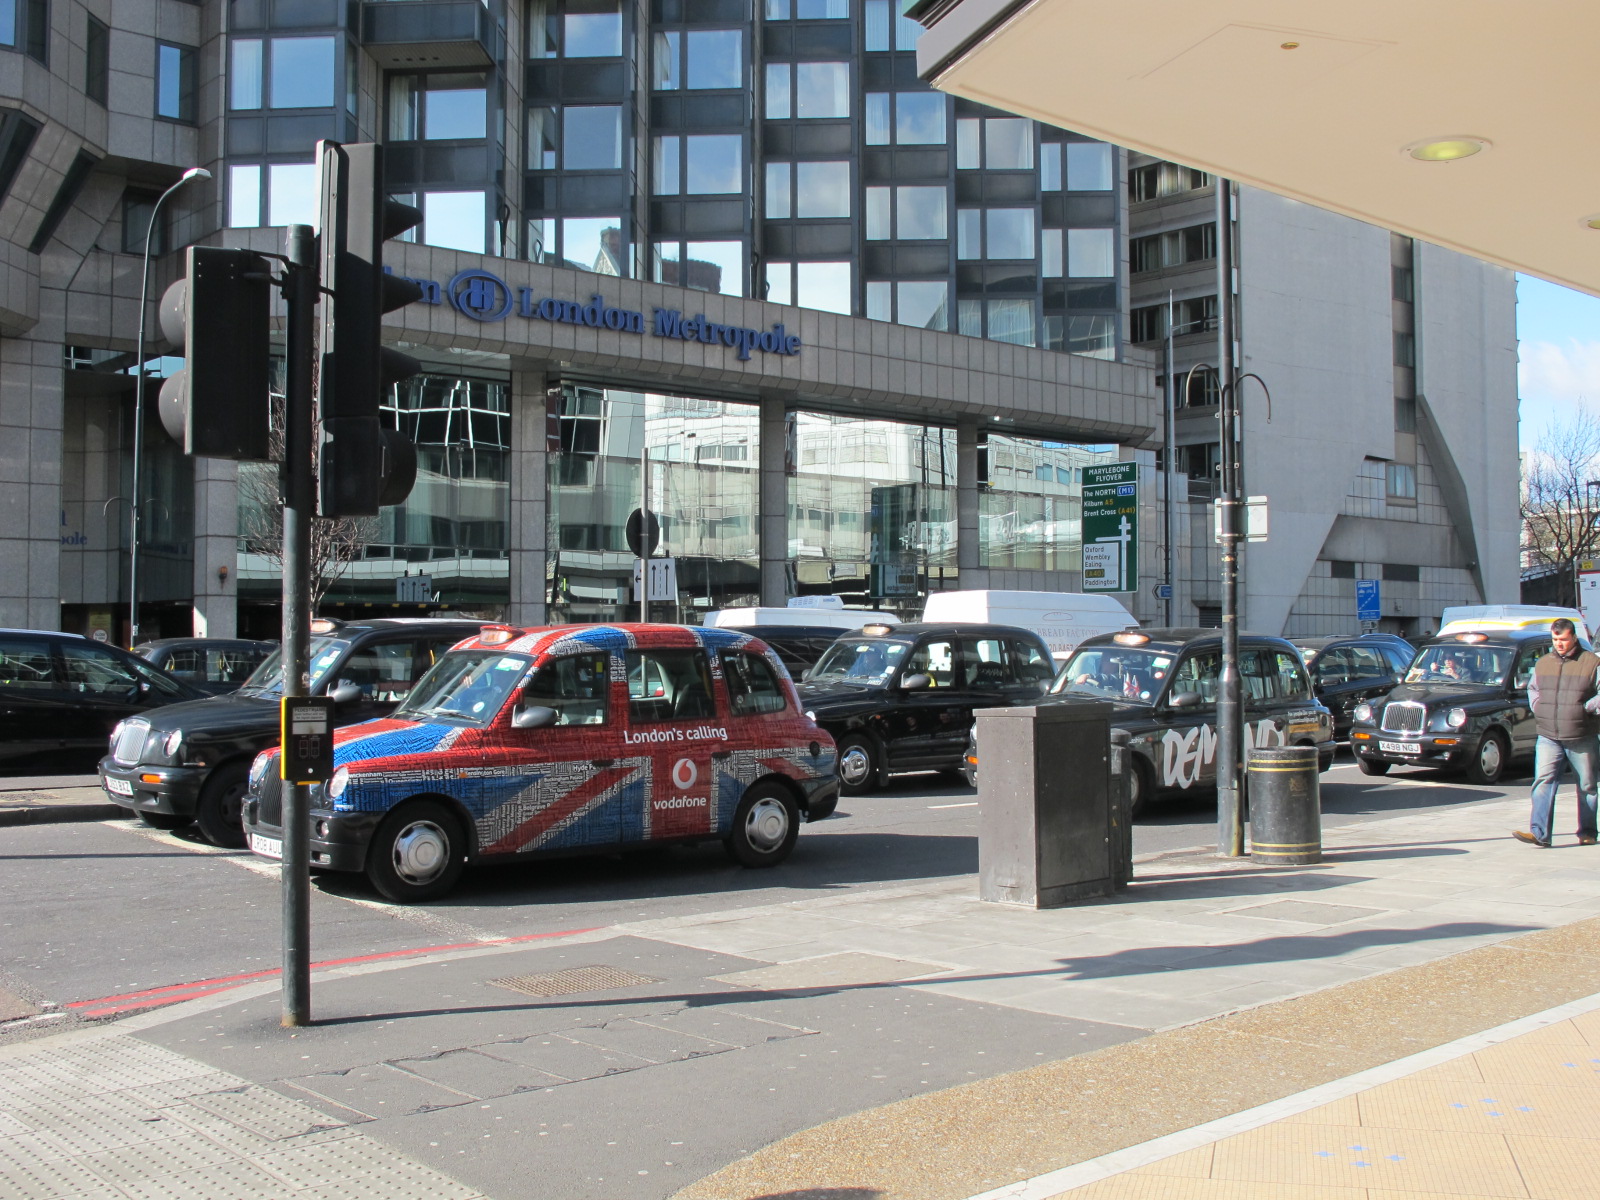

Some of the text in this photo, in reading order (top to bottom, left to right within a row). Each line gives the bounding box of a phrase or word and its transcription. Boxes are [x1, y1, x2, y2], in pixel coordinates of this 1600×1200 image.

[517, 286, 802, 362] London Metropole
[1088, 466, 1130, 476] MARYLEBONE
[1096, 474, 1122, 482] FLYOVER
[1094, 488, 1116, 496] NORTH
[1118, 486, 1134, 495] (M1)
[1118, 507, 1136, 515] (A41)
[1037, 628, 1064, 637] BREAD
[1066, 629, 1100, 638] FACTORY
[624, 726, 728, 744] London's calling
[1381, 742, 1400, 750] X498
[654, 796, 706, 810] vodafone
